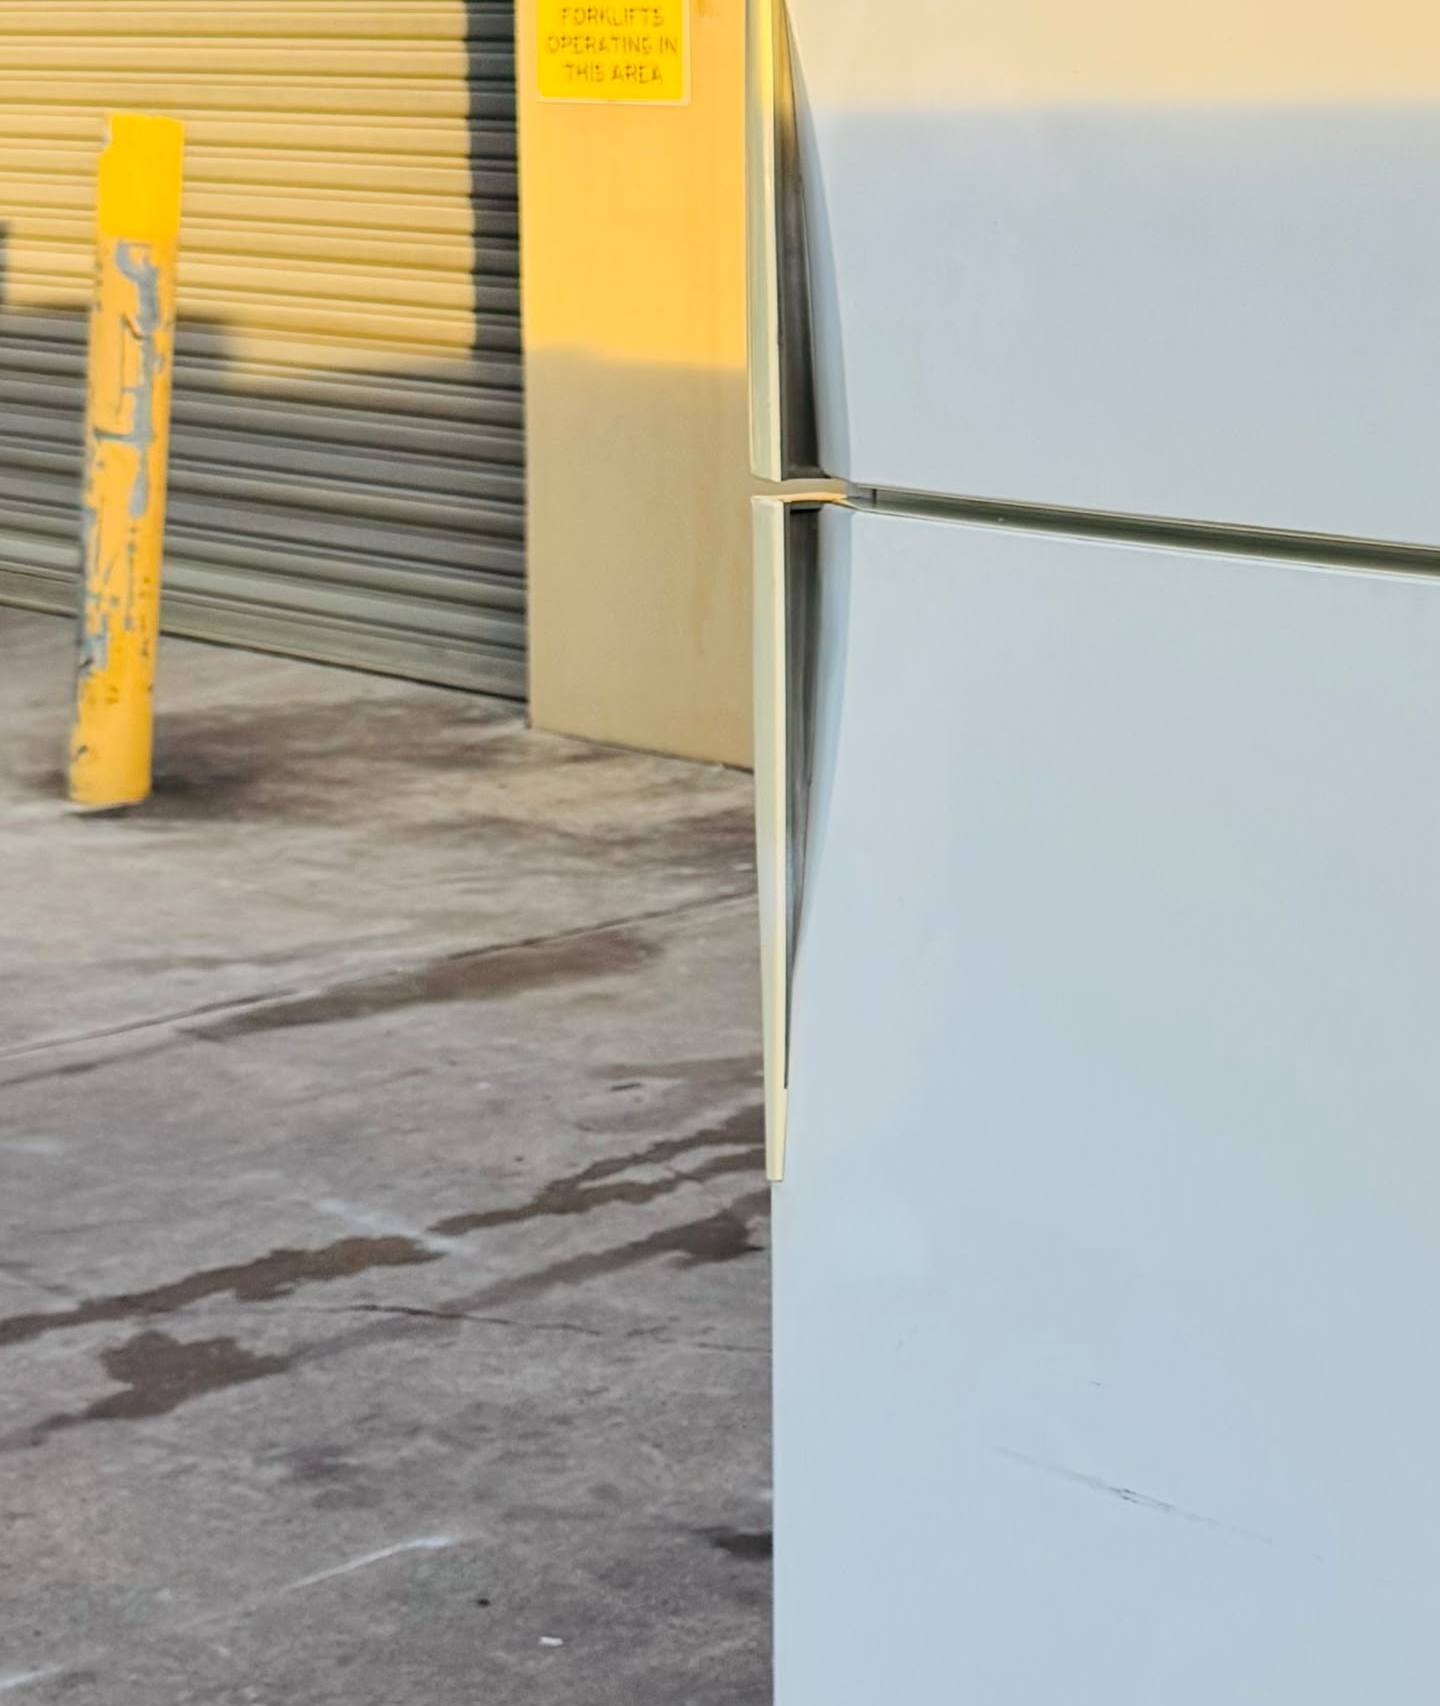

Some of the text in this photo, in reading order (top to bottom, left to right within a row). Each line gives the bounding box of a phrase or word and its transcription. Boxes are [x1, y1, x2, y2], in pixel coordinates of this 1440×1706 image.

[560, 6, 665, 27] FORKLIFTS
[546, 35, 678, 55] OPERATING IN
[564, 62, 663, 84] THIS AREA
